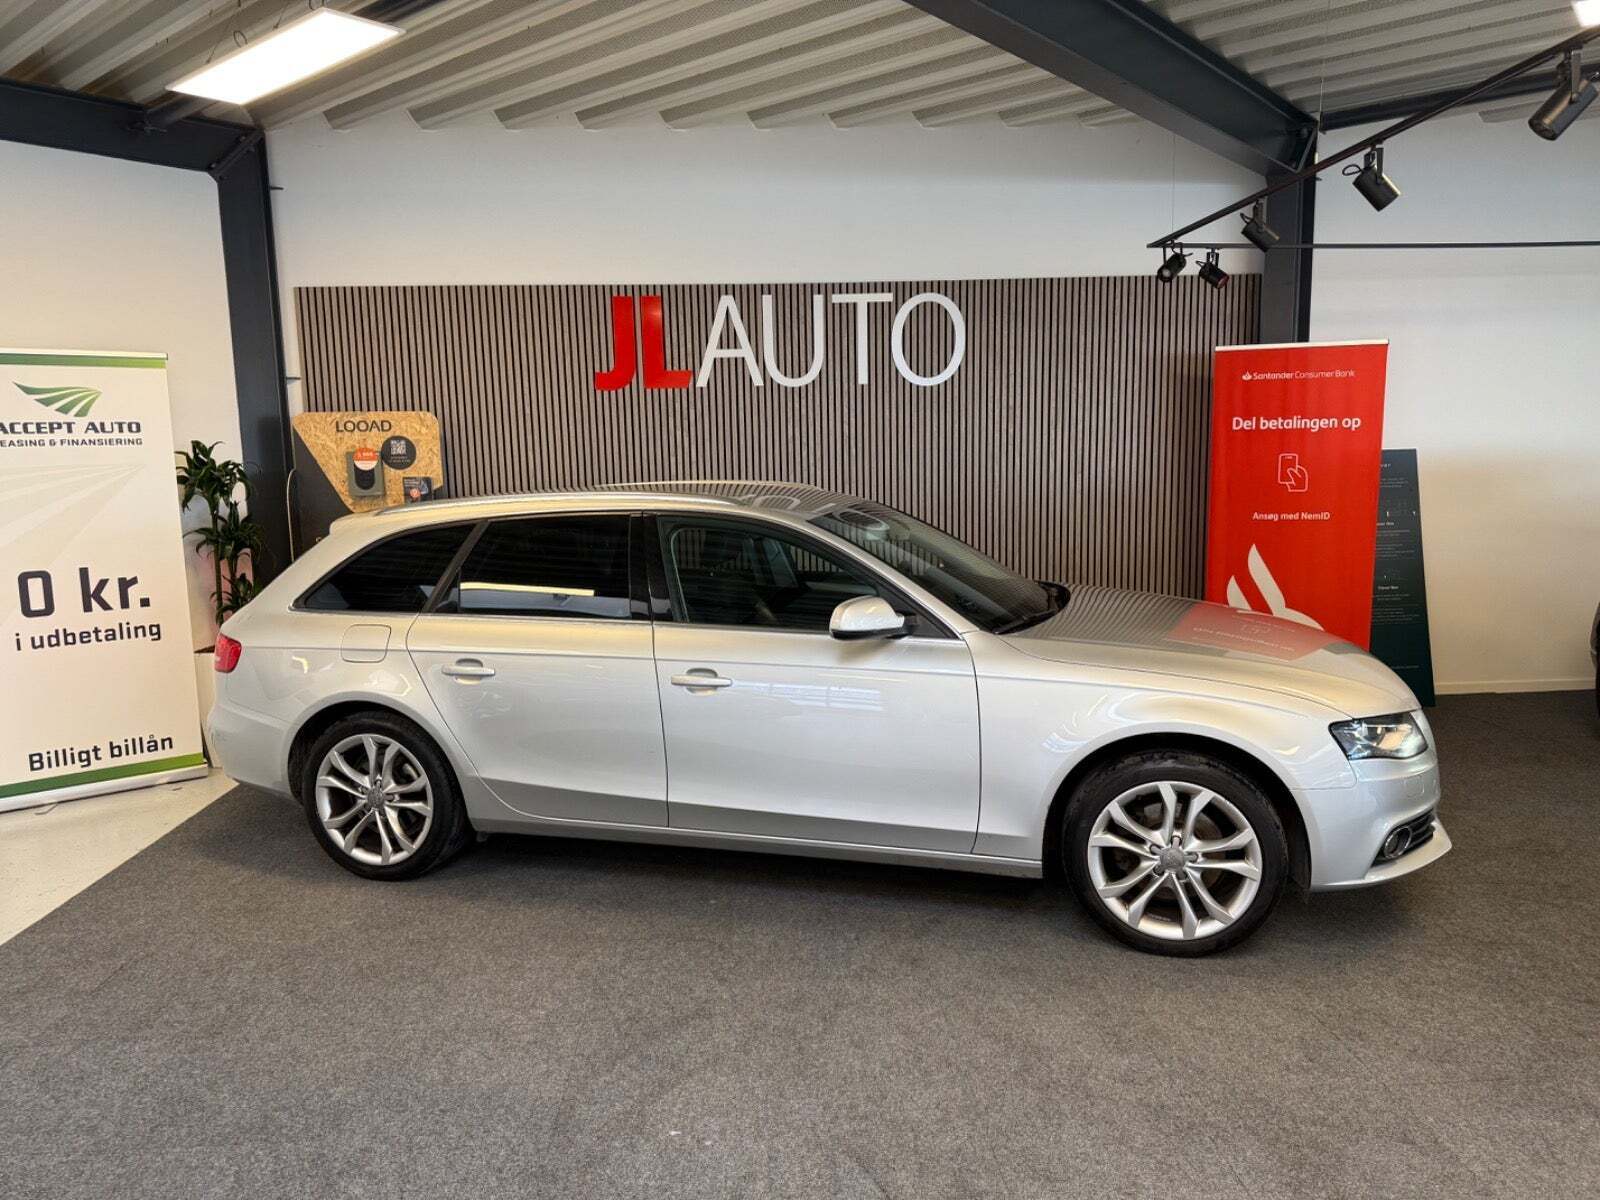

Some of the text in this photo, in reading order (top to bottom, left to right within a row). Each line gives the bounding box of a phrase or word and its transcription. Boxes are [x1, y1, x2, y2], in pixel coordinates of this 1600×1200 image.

[1253, 369, 1355, 380] Santander Consumer Bank
[84, 421, 142, 433] AUTO
[335, 420, 392, 432] LOOAD
[1232, 415, 1361, 432] Del betalingen op
[0, 437, 143, 447] EASING & FINANSIERING
[1252, 511, 1331, 521] Ansøg med NemID
[18, 567, 151, 618] 0 kr.
[15, 621, 161, 651] i udbetaling
[28, 734, 173, 769] Billigt billån
